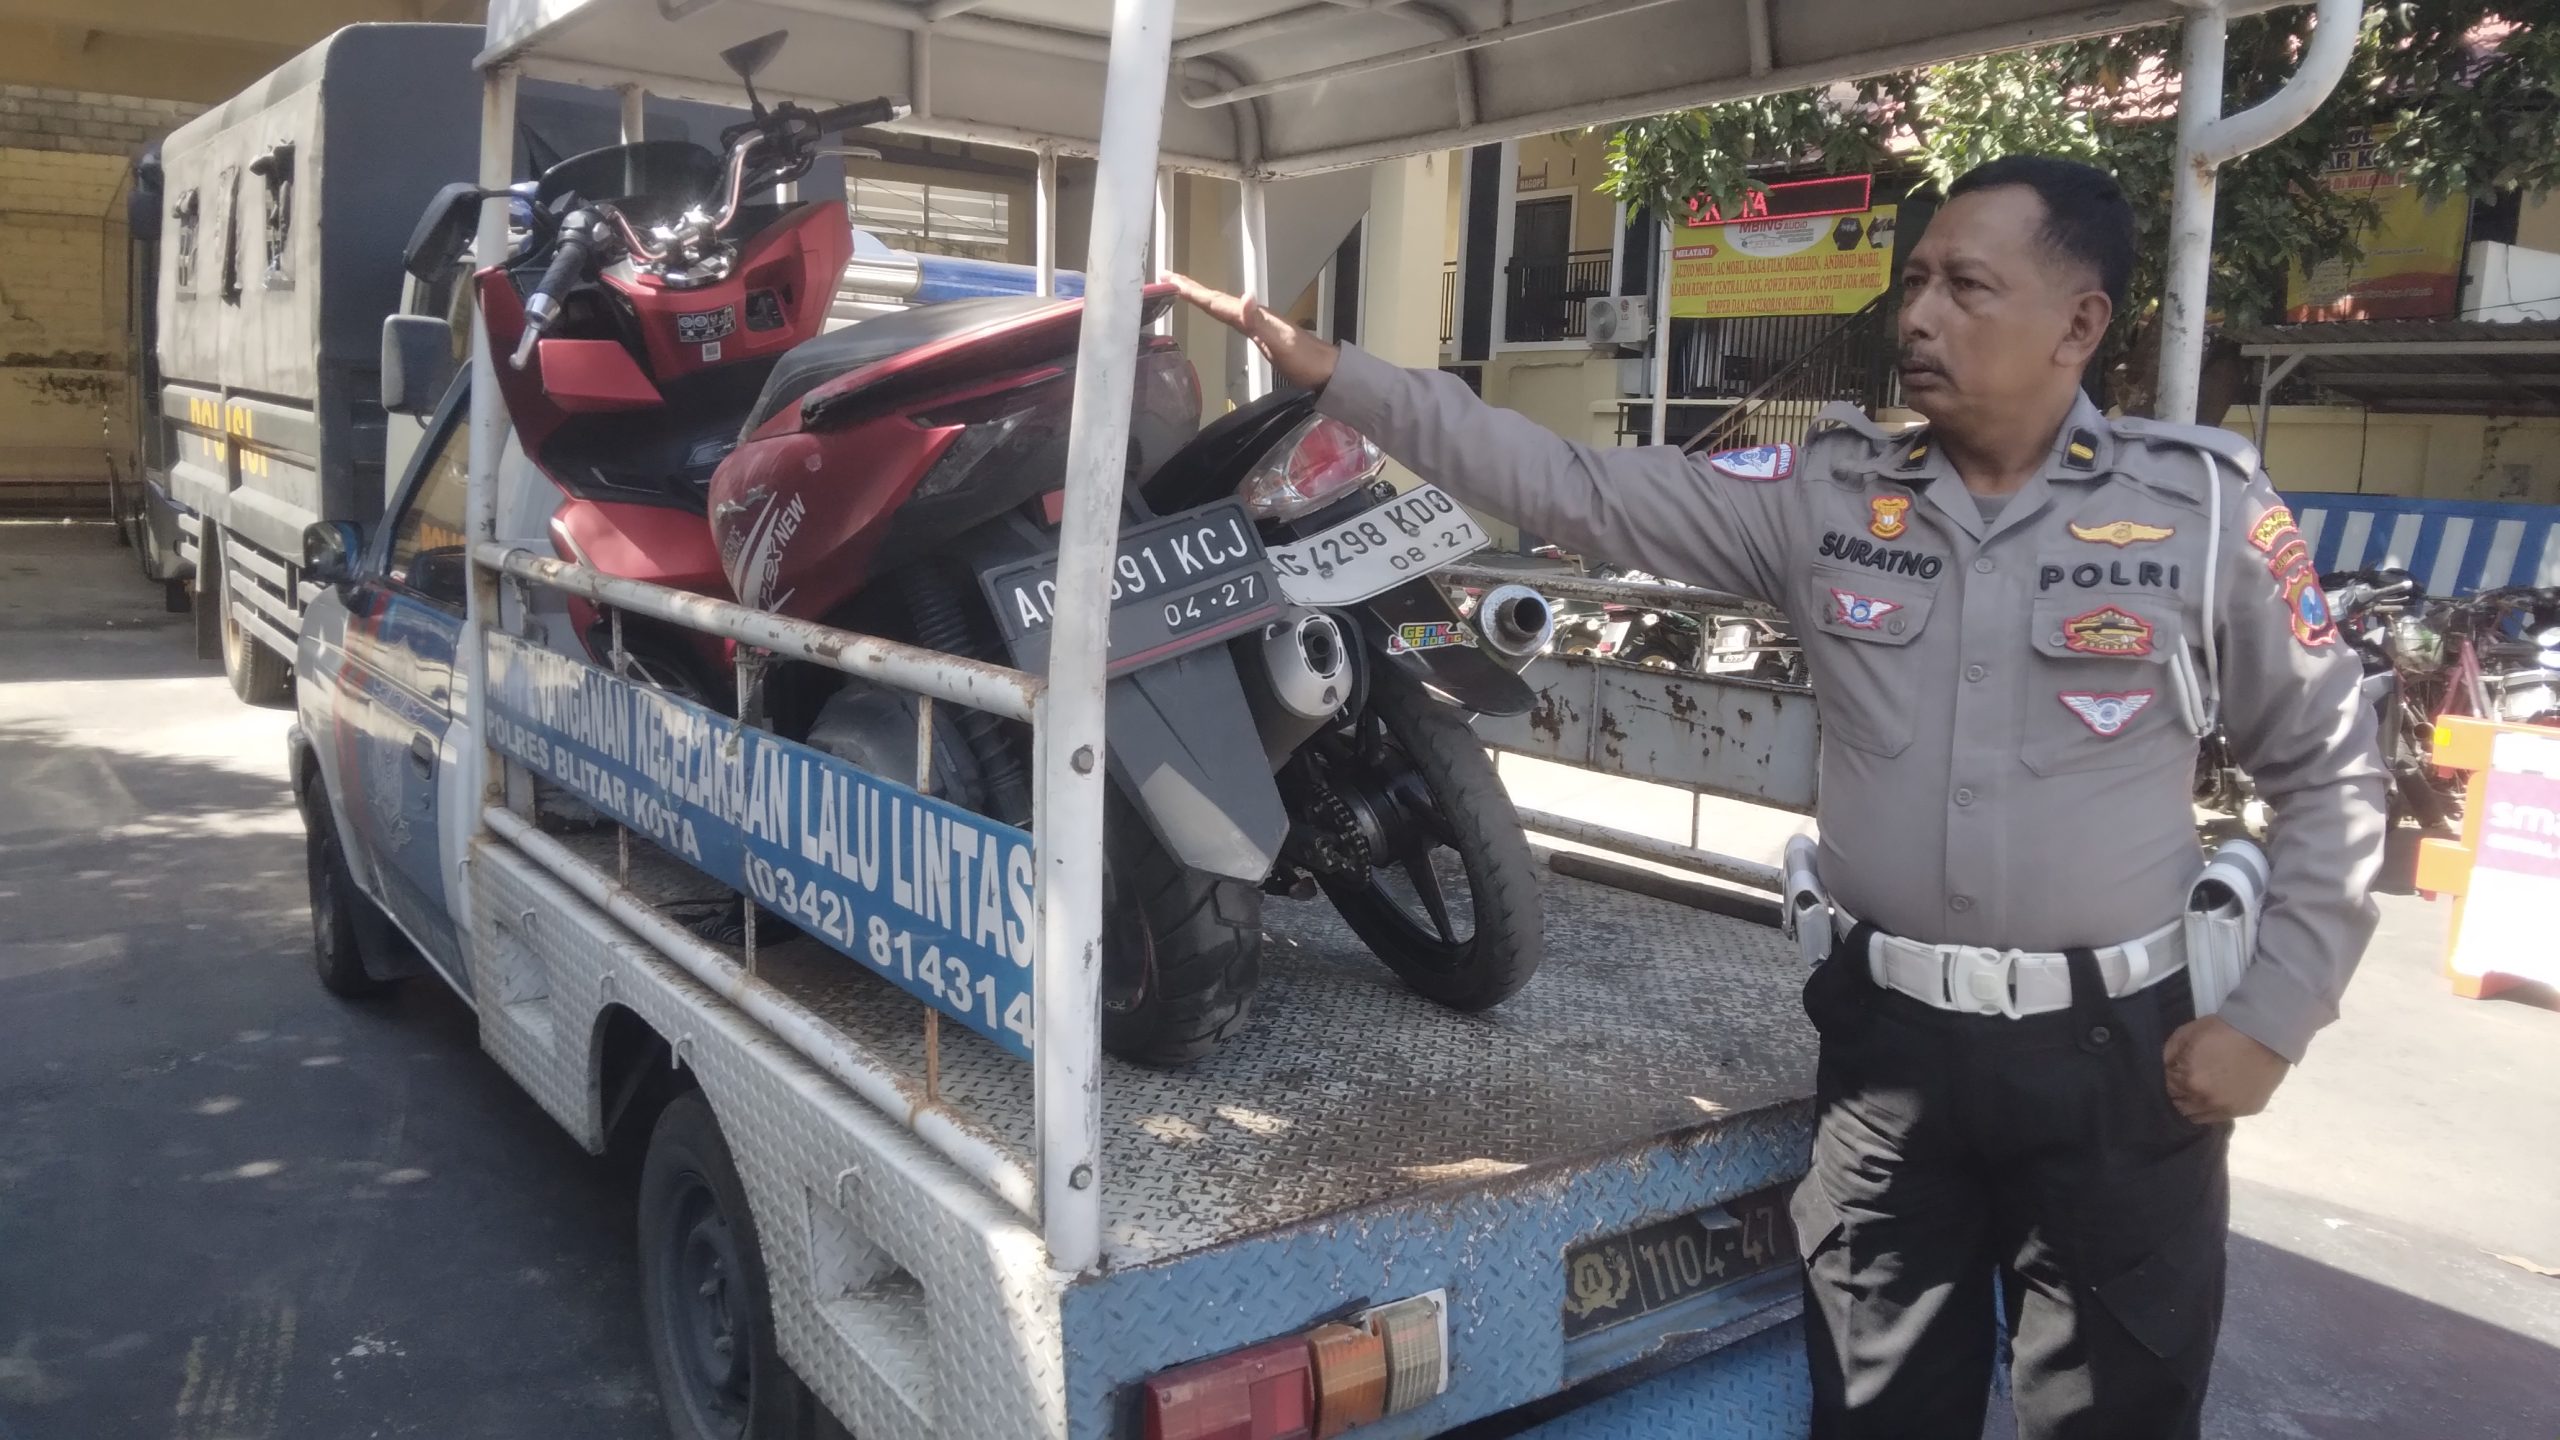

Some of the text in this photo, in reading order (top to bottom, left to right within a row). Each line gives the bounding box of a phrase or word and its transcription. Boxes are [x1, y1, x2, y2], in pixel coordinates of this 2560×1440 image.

[1820, 274, 1842, 289] COVER
[773, 492, 806, 547] NEW
[1170, 518, 1248, 575] KCJ
[1310, 521, 1388, 578] 4298
[1819, 530, 1943, 579] SURATNO
[2040, 560, 2181, 591] POLRI
[486, 706, 702, 862] POLRES BLITAR KOTA
[636, 687, 791, 850] KECELAKAAN
[801, 759, 881, 892] LALU
[893, 798, 1034, 968] LINTAS
[744, 849, 1034, 1049] (0342) 814314
